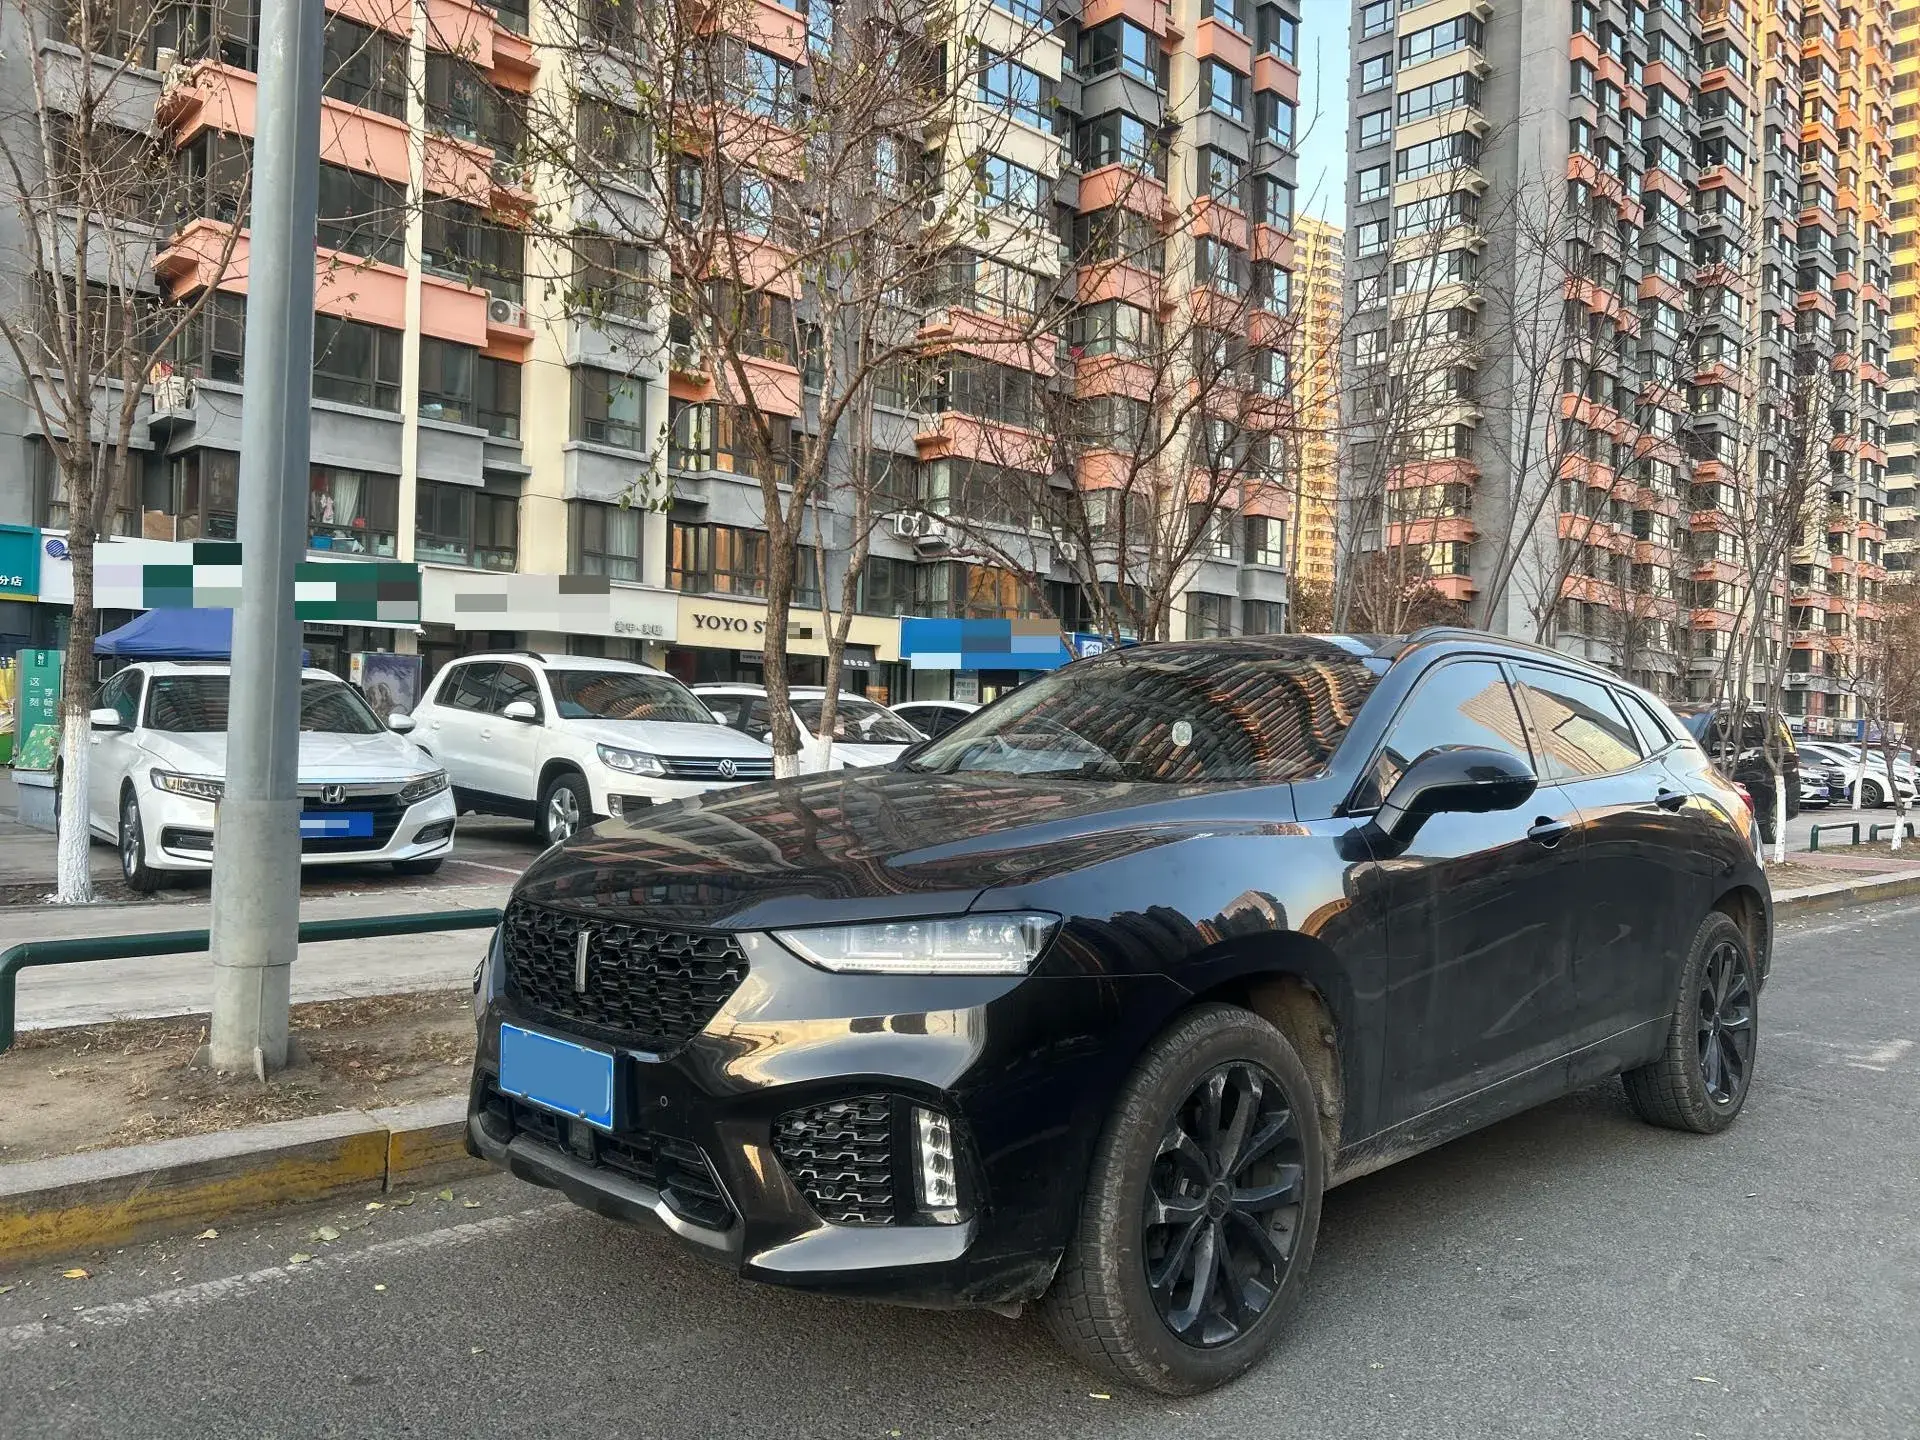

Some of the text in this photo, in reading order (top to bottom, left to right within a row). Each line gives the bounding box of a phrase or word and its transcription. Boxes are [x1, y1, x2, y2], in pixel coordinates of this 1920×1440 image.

[0, 575, 23, 587] 分店
[693, 614, 748, 633] YOYO
[29, 677, 40, 707] 这一刻
